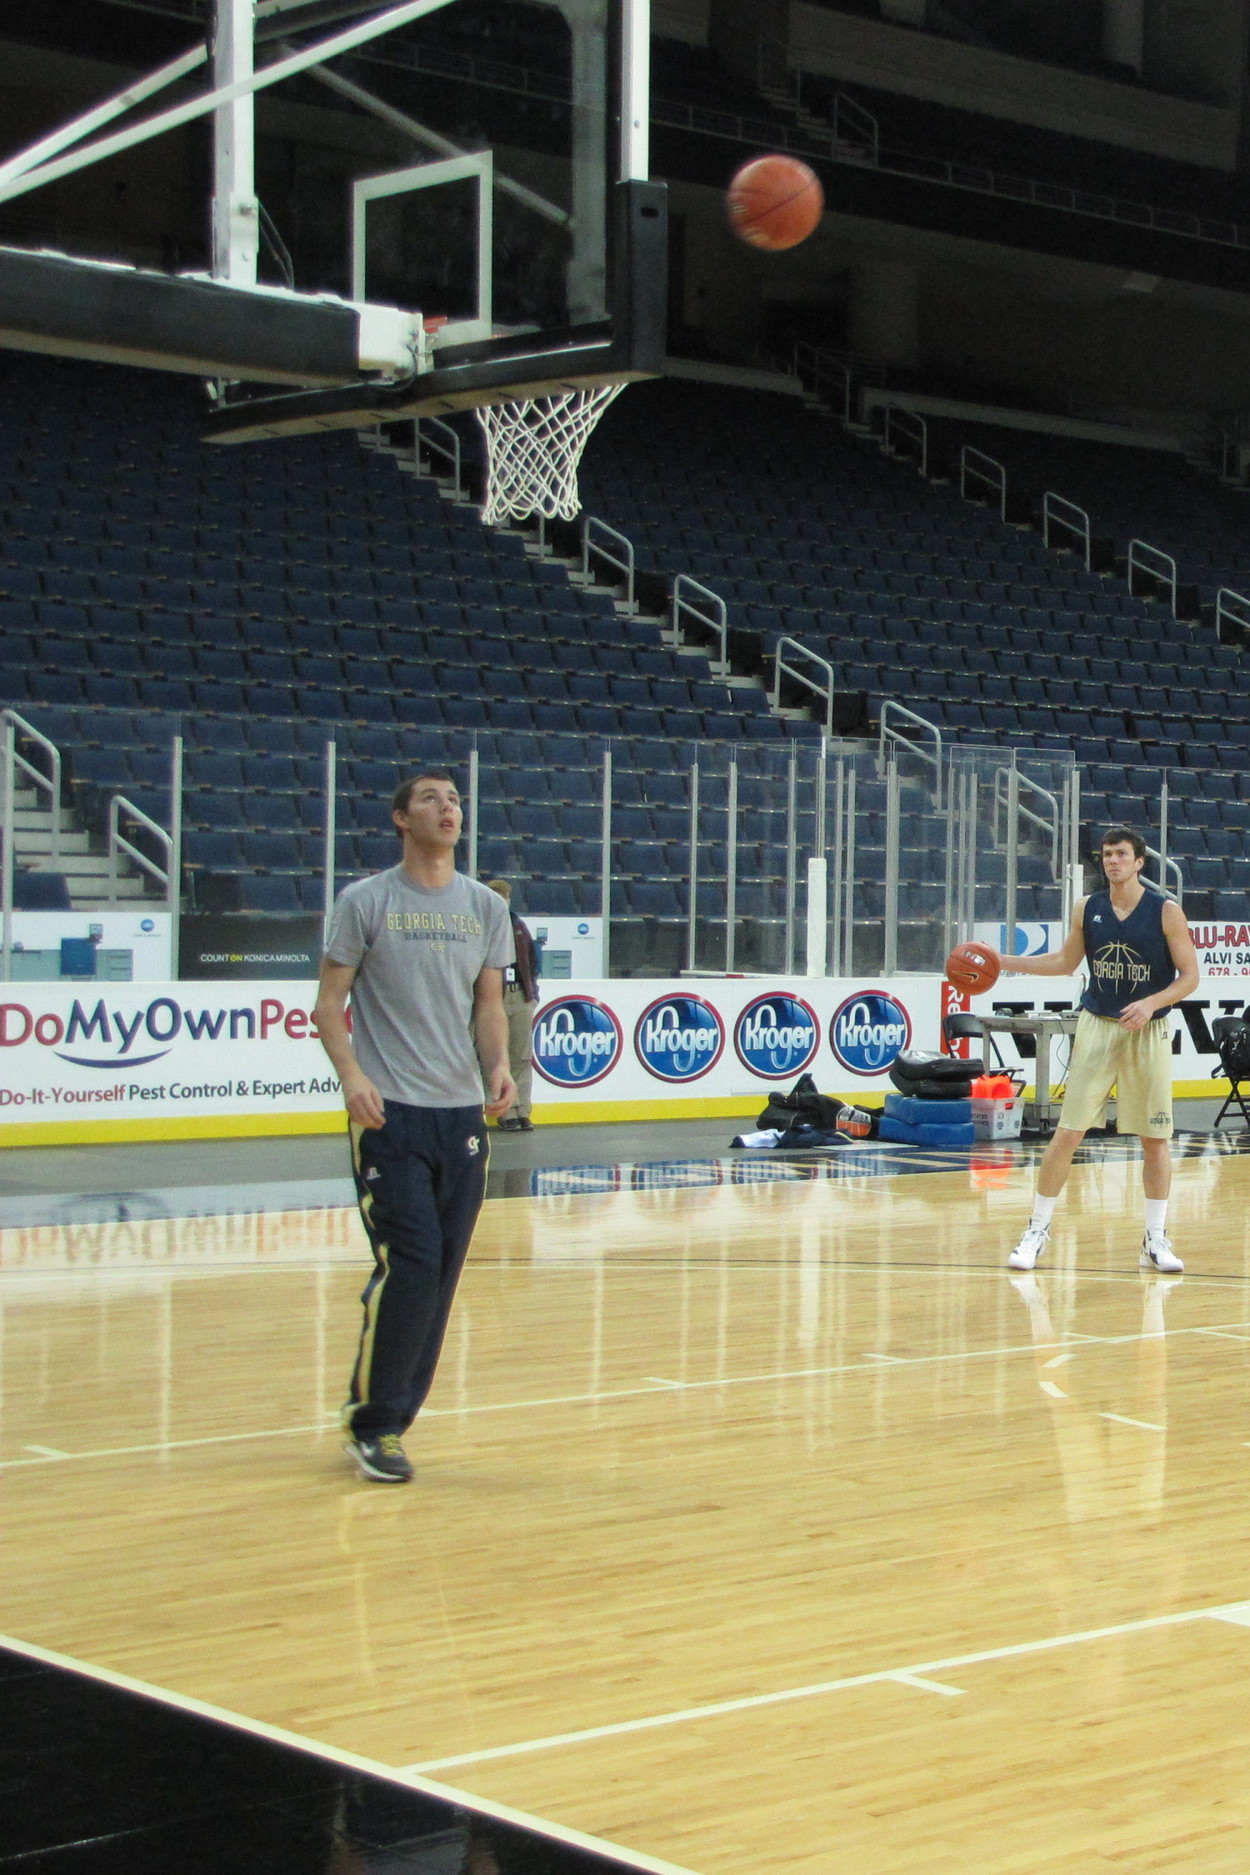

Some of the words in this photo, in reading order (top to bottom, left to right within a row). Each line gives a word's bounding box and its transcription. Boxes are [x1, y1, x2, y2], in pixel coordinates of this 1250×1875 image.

[387, 913, 446, 930] GEORGIA
[451, 914, 483, 935] TECH
[1093, 959, 1124, 979] GORGIA
[1127, 964, 1151, 981] TECH
[1204, 952, 1231, 964] ALVI
[0, 997, 320, 1055] DoMyOwnPes
[540, 1008, 615, 1077] Kroger
[646, 1005, 717, 1073] Kroger
[745, 1004, 813, 1070] Kroger
[840, 1002, 905, 1066] Kroger
[0, 1084, 126, 1107] Do-It-Yourself
[129, 1082, 165, 1100] Pest
[169, 1079, 233, 1099] Control
[237, 1081, 249, 1096] &
[253, 1078, 306, 1100] Expert
[309, 1077, 341, 1094] Adv
